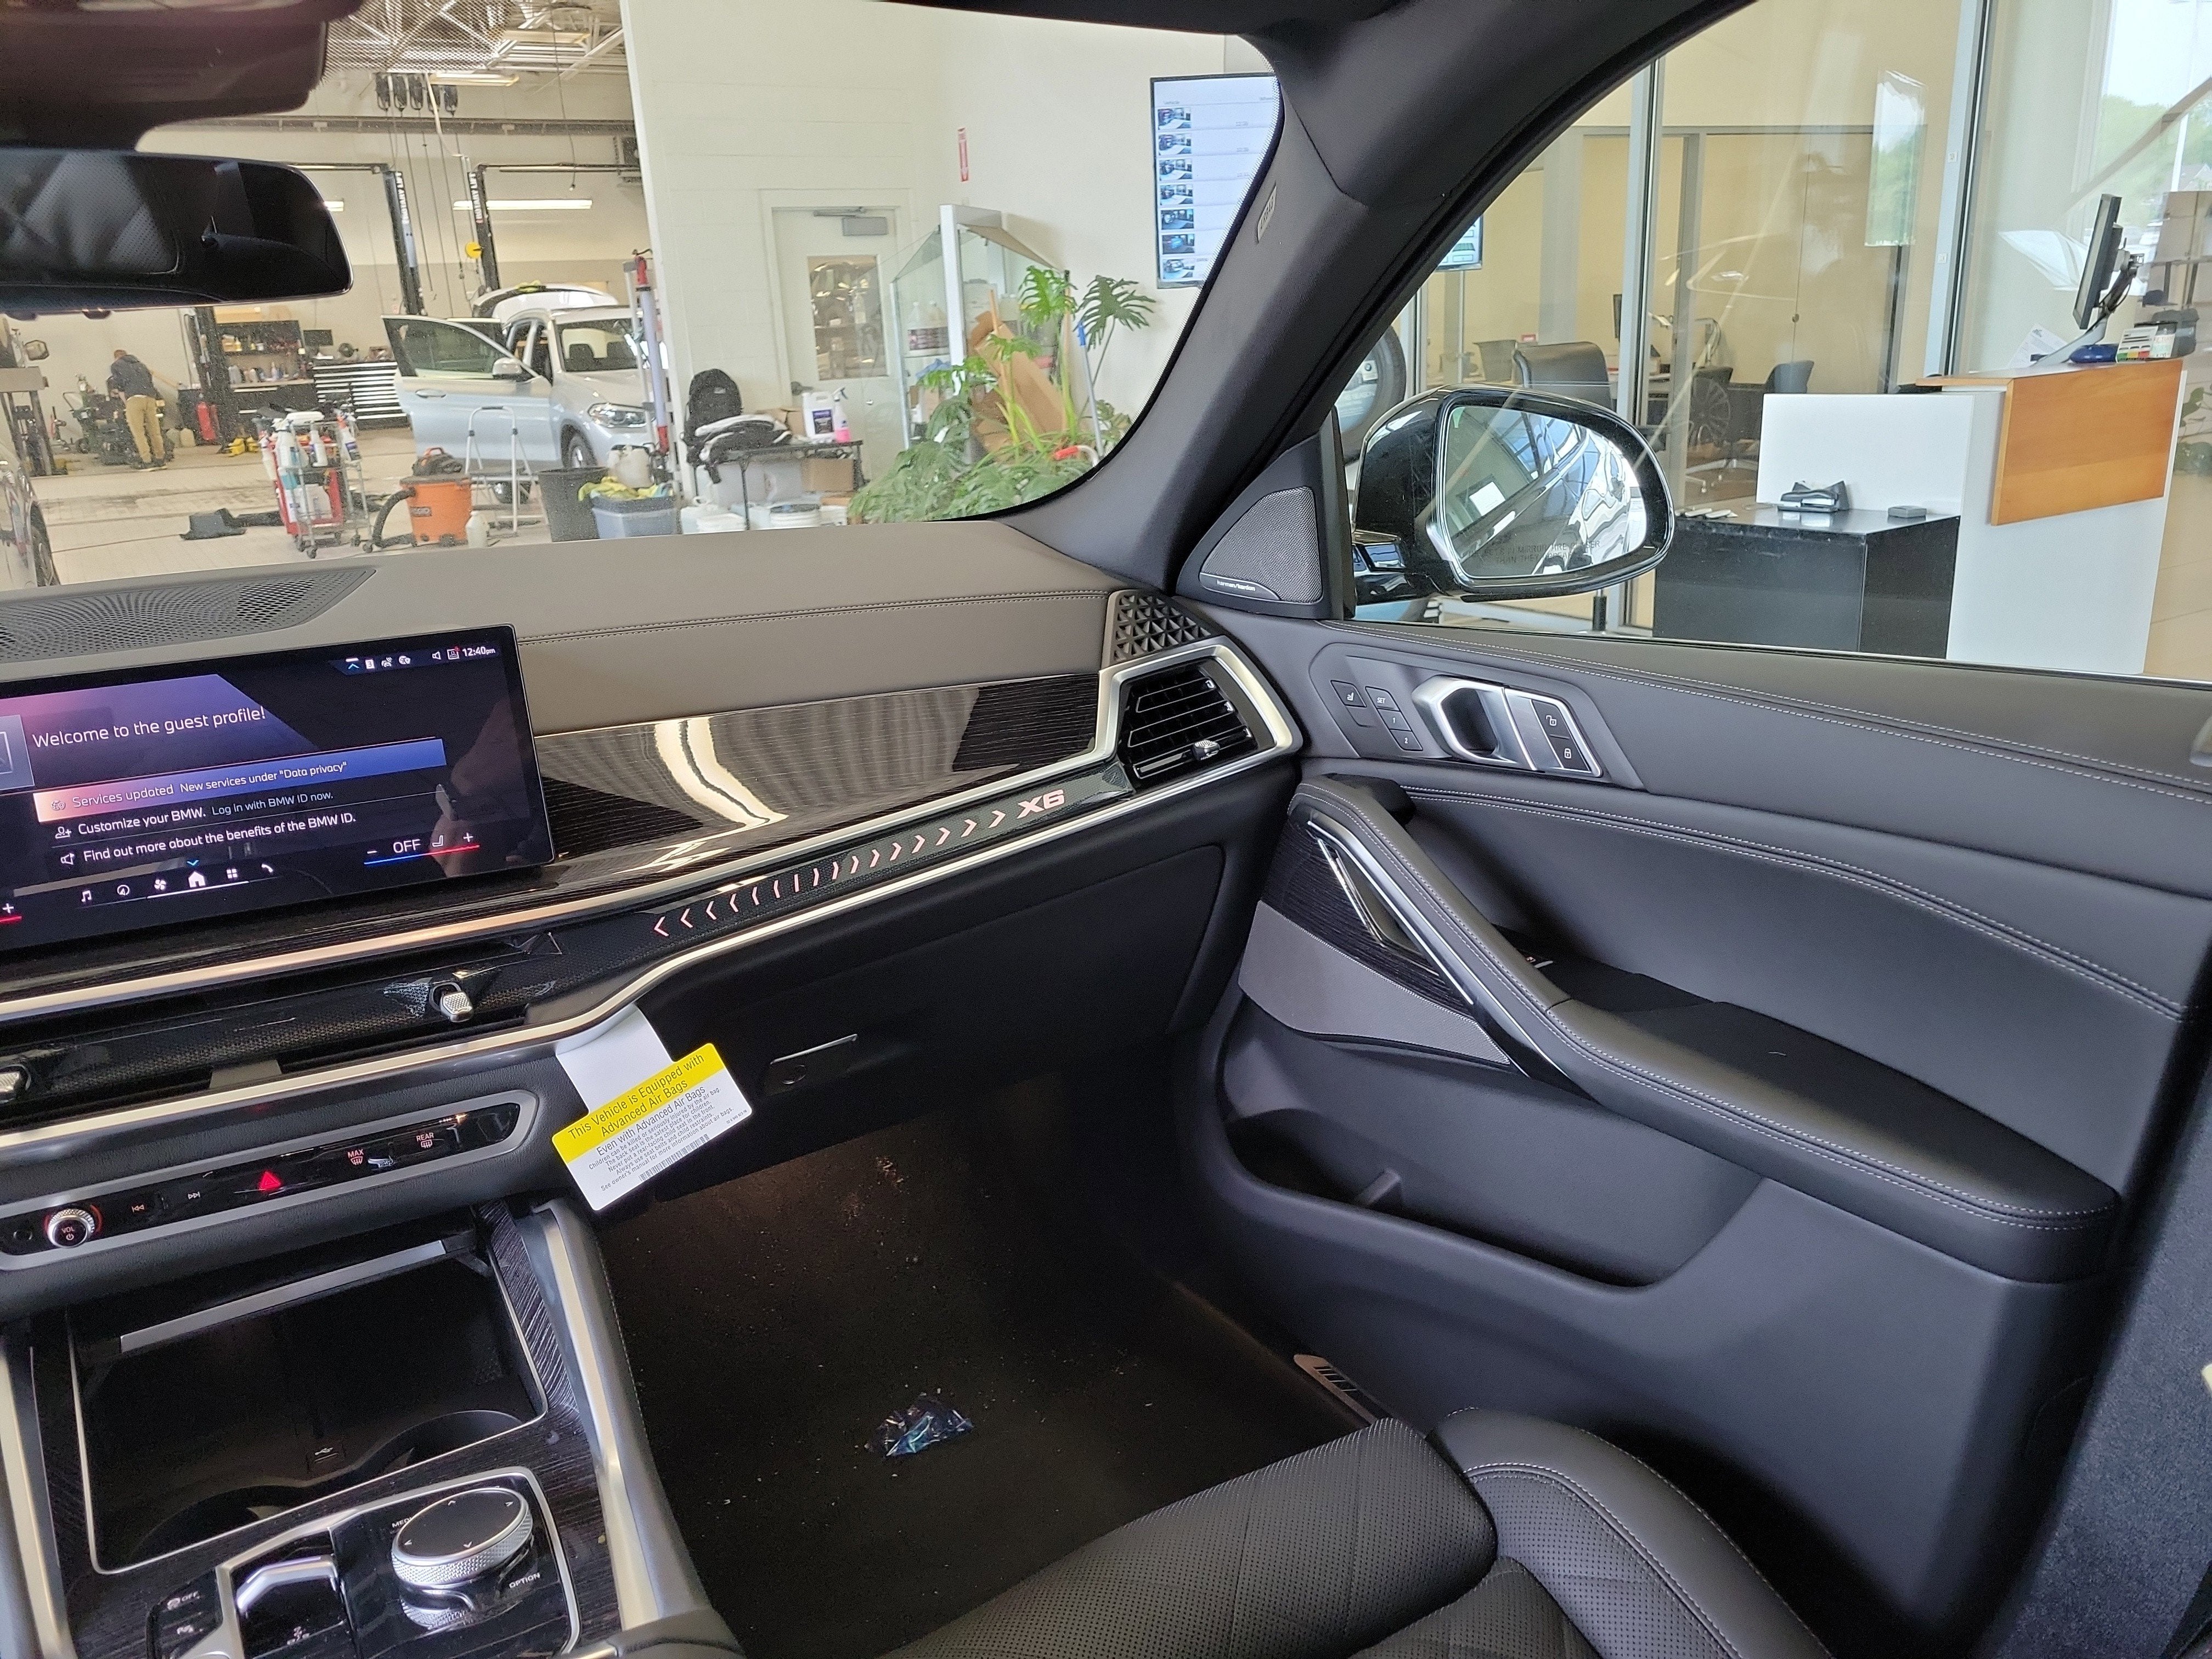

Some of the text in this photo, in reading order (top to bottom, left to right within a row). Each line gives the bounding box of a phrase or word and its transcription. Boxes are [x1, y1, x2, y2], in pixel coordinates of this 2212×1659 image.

[462, 646, 496, 656] 12:40pm
[32, 706, 266, 748] Welcome to the guest profile!
[72, 784, 174, 807] Services updated
[180, 761, 347, 793] New services under "Data privacy"
[78, 806, 206, 834] Customize your BMW.
[212, 792, 334, 815] Log in with BMW ID now.
[1016, 789, 1065, 819] X6
[83, 812, 356, 862] Find out more about the benefits of the BMW ID.
[392, 838, 422, 854] OFF
[568, 1054, 704, 1139] This Vehicle is Equipped with
[601, 1080, 687, 1137] Advanced Air Bags
[416, 1132, 435, 1142] REAR
[589, 1155, 611, 1170] Children
[627, 1135, 641, 1147] killed
[648, 1118, 670, 1133] seriously
[669, 1107, 687, 1120] injured
[709, 1087, 721, 1096] bag.
[596, 1086, 706, 1156] Even with Advanced Air Bags
[608, 1160, 623, 1172] Never
[624, 1154, 633, 1164] put
[637, 1136, 664, 1155] rear-facing
[664, 1127, 676, 1138] child
[676, 1121, 687, 1130] seat
[701, 1104, 714, 1115] front.
[615, 1150, 629, 1160] back
[628, 1143, 640, 1153] seat
[654, 1125, 669, 1137] safest
[669, 1118, 682, 1128] place
[691, 1101, 712, 1114] children.
[347, 1148, 364, 1158] MAX
[601, 1183, 611, 1191] See
[612, 1170, 631, 1184] owner's
[631, 1158, 650, 1172] manual
[658, 1146, 671, 1156] more
[671, 1128, 699, 1147] information
[699, 1119, 714, 1130] about
[720, 1108, 734, 1117] bags.
[616, 1113, 713, 1175] Always use seat belts and child restraints.
[509, 1572, 540, 1589] OPTION
